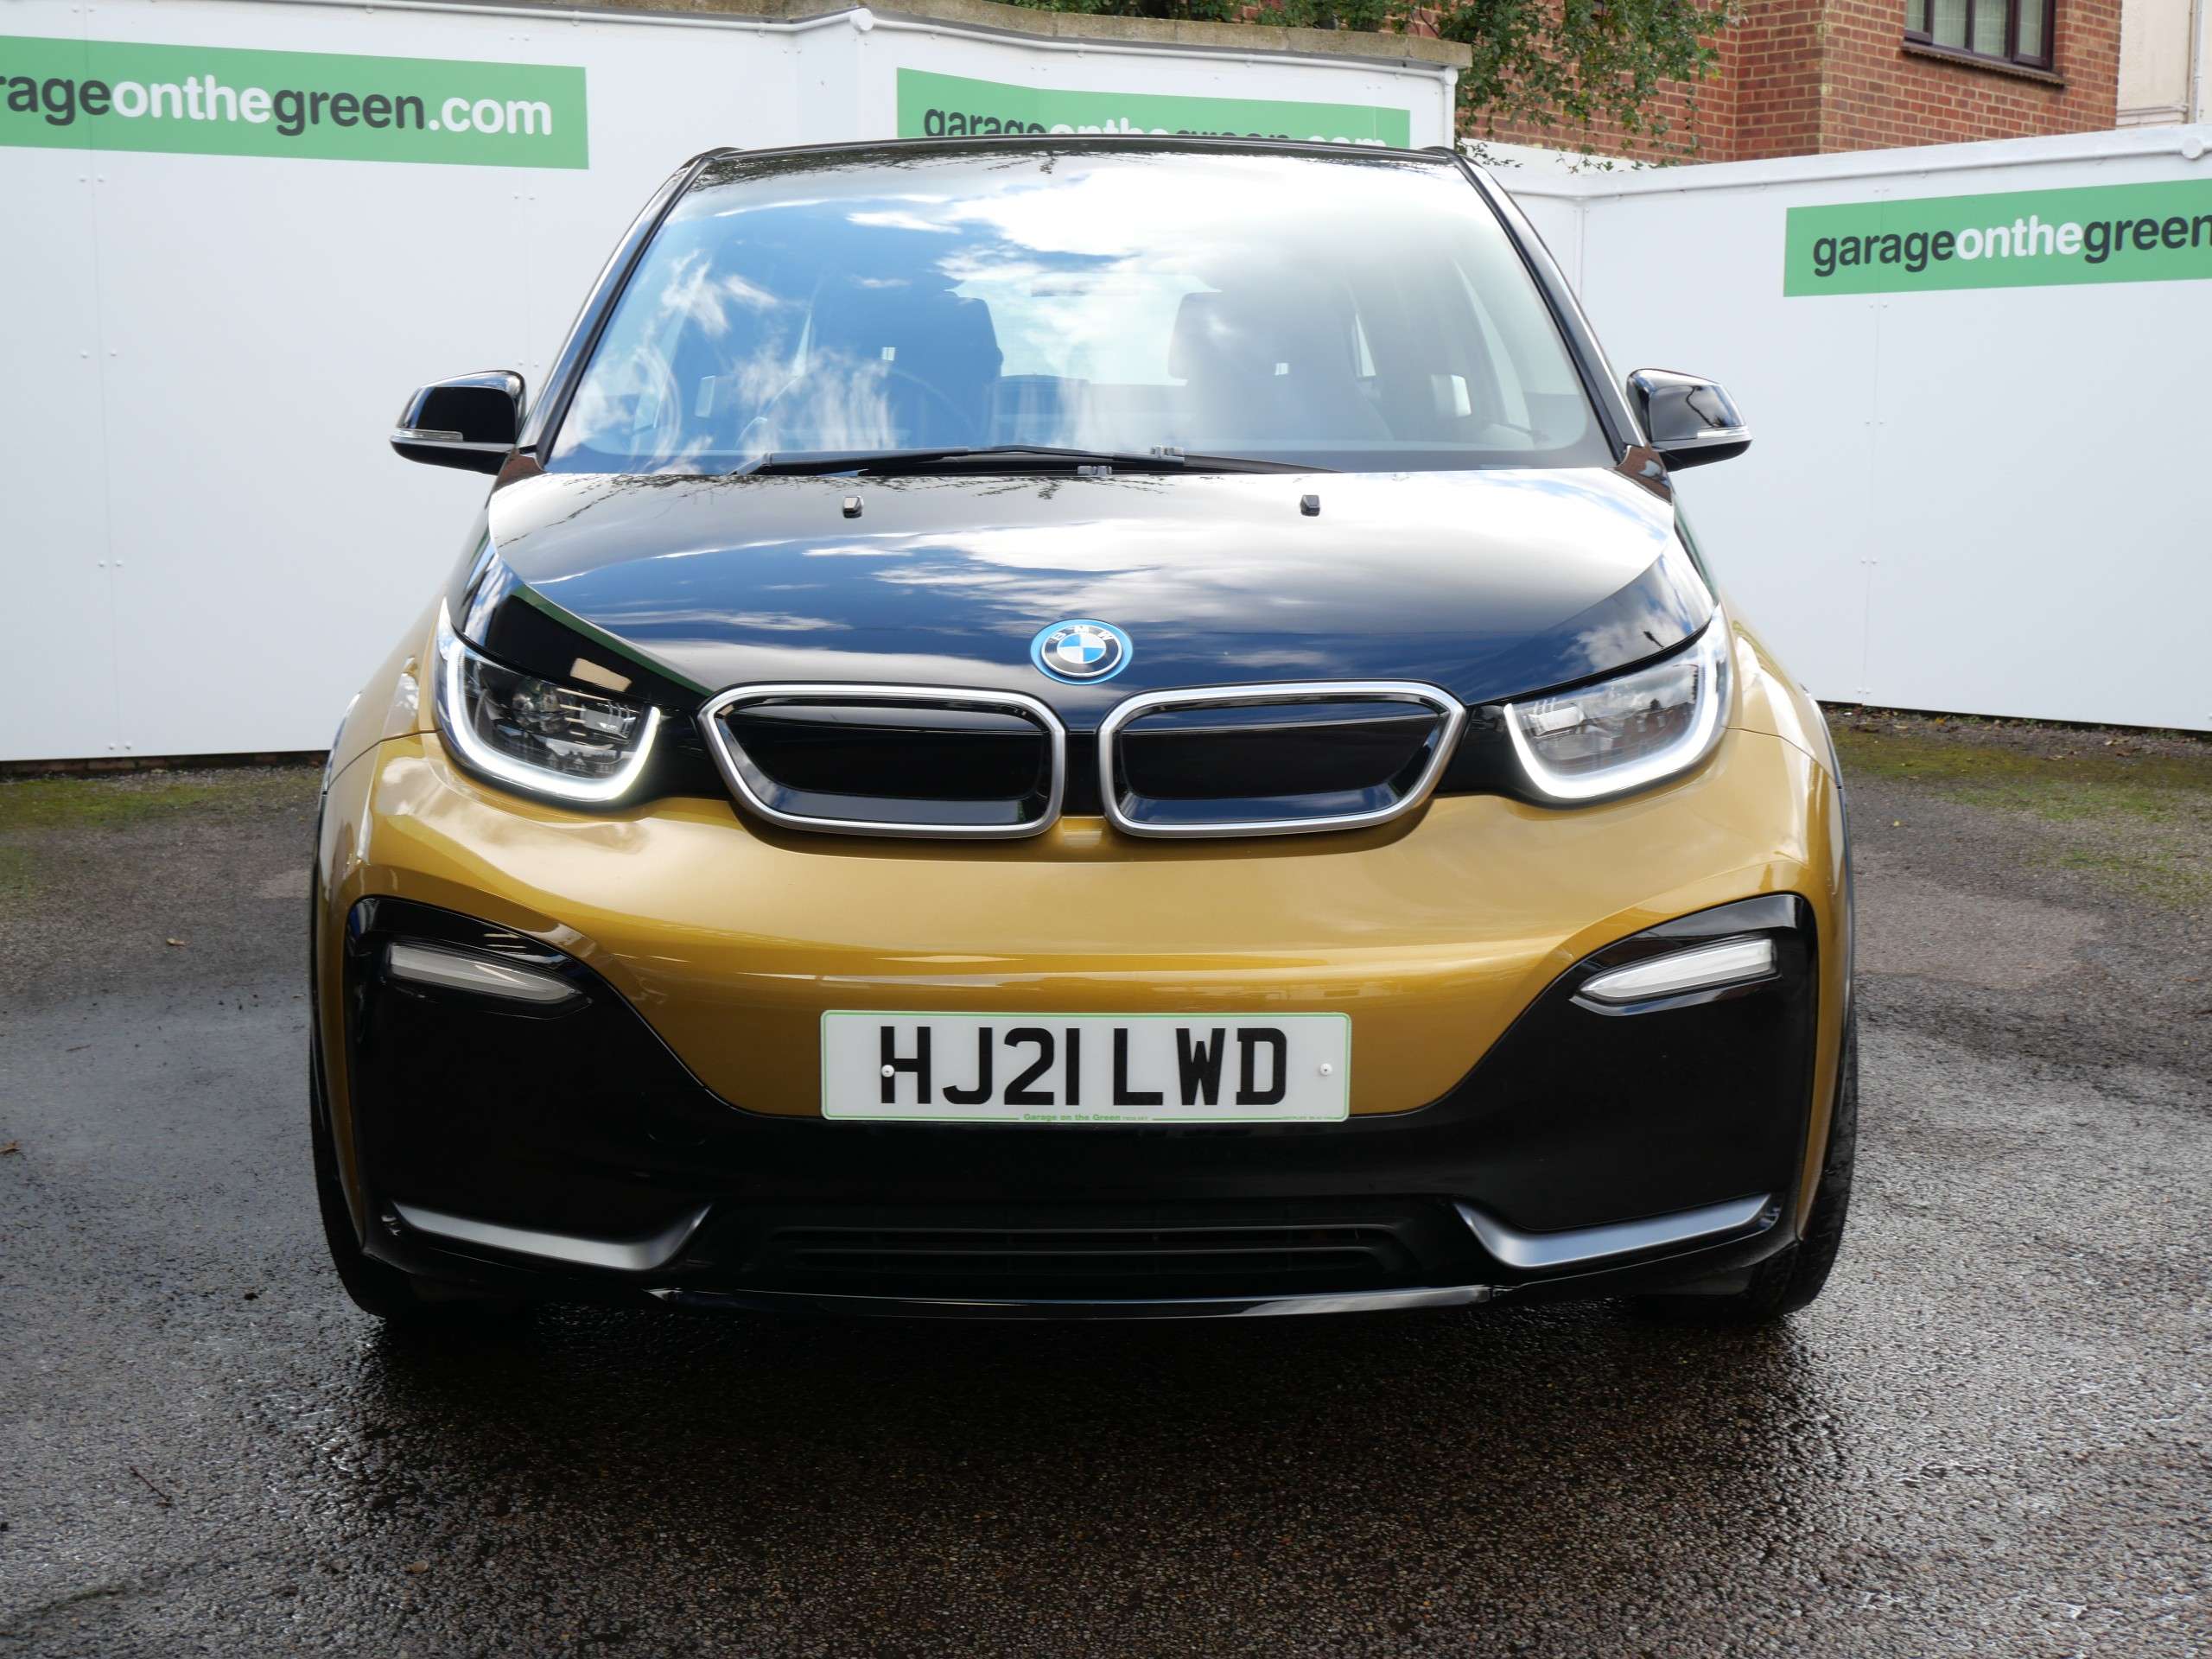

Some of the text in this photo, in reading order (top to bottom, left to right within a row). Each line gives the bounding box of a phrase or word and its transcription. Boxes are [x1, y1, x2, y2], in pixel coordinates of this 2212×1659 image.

[0, 74, 552, 137] ageonthegreen.com
[1814, 215, 2212, 276] garageonthegreen
[880, 1026, 1287, 1106] HJ21 LWD
[1023, 1113, 1057, 1122] Garage
